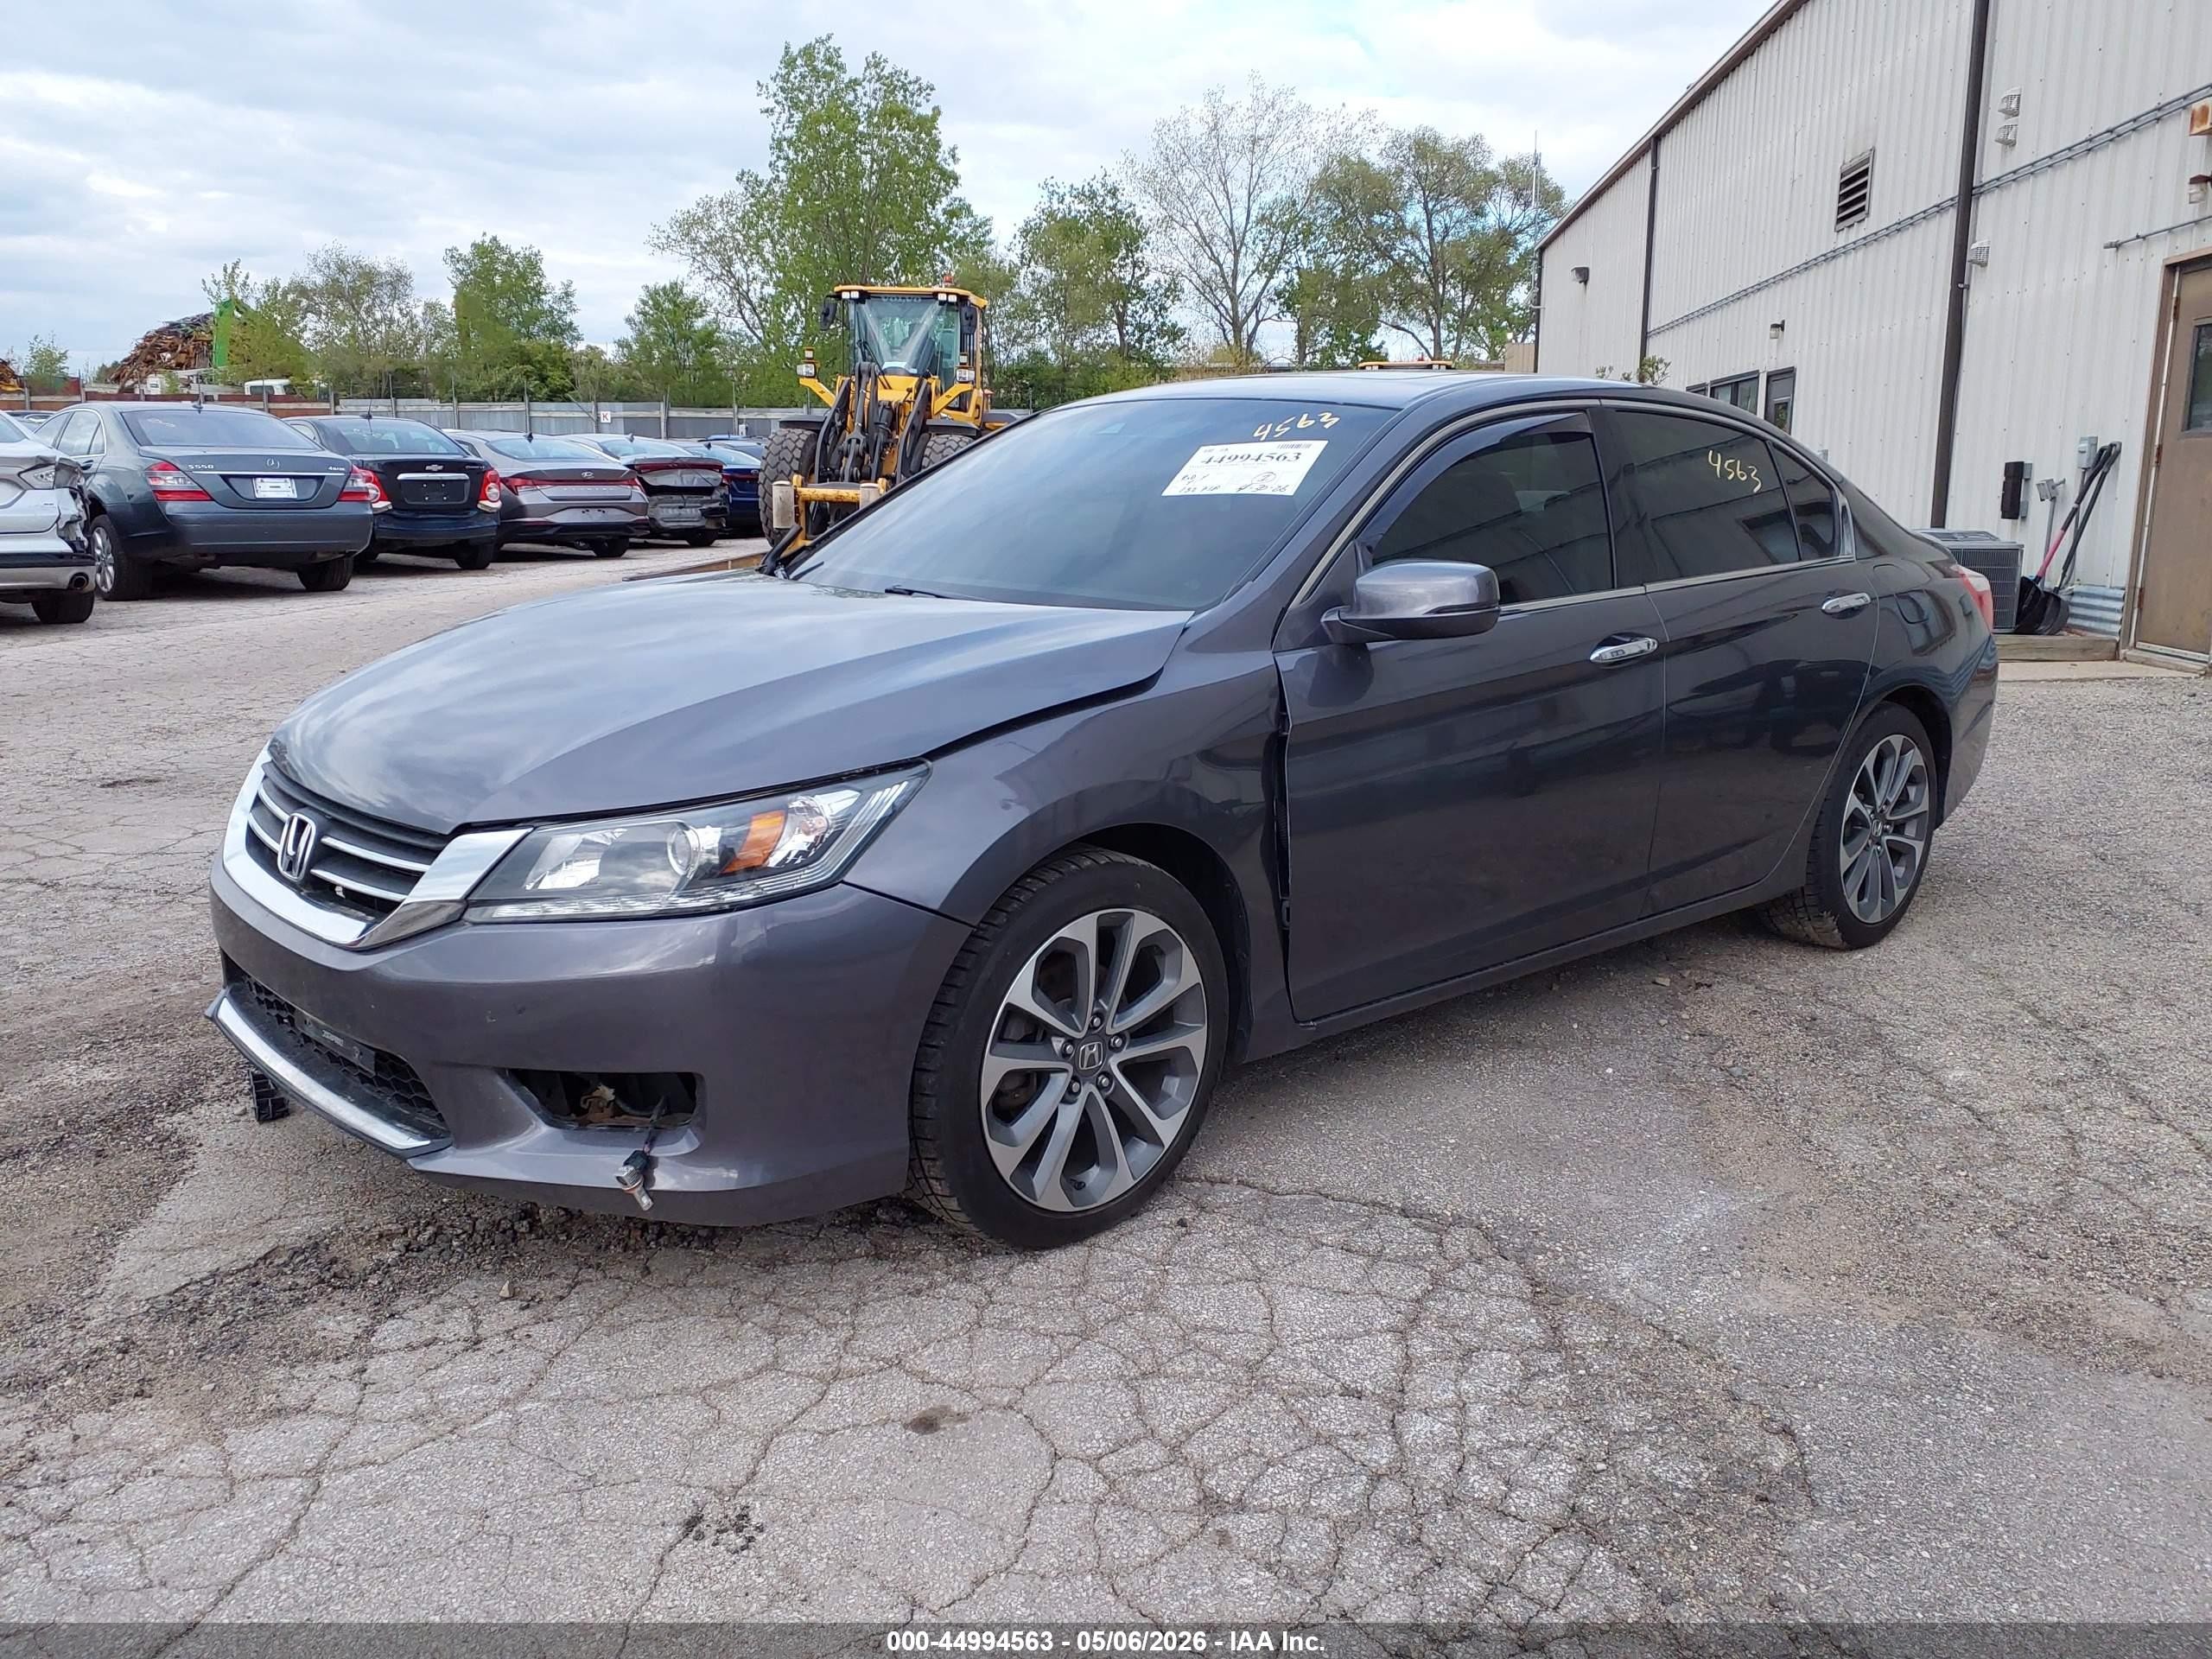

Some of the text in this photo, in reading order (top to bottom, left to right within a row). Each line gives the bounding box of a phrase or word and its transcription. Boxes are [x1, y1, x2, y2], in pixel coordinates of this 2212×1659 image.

[602, 413, 609, 422] K
[1253, 411, 1341, 441] 4563
[1200, 452, 1302, 464] 44994563
[1708, 449, 1762, 493] 4563
